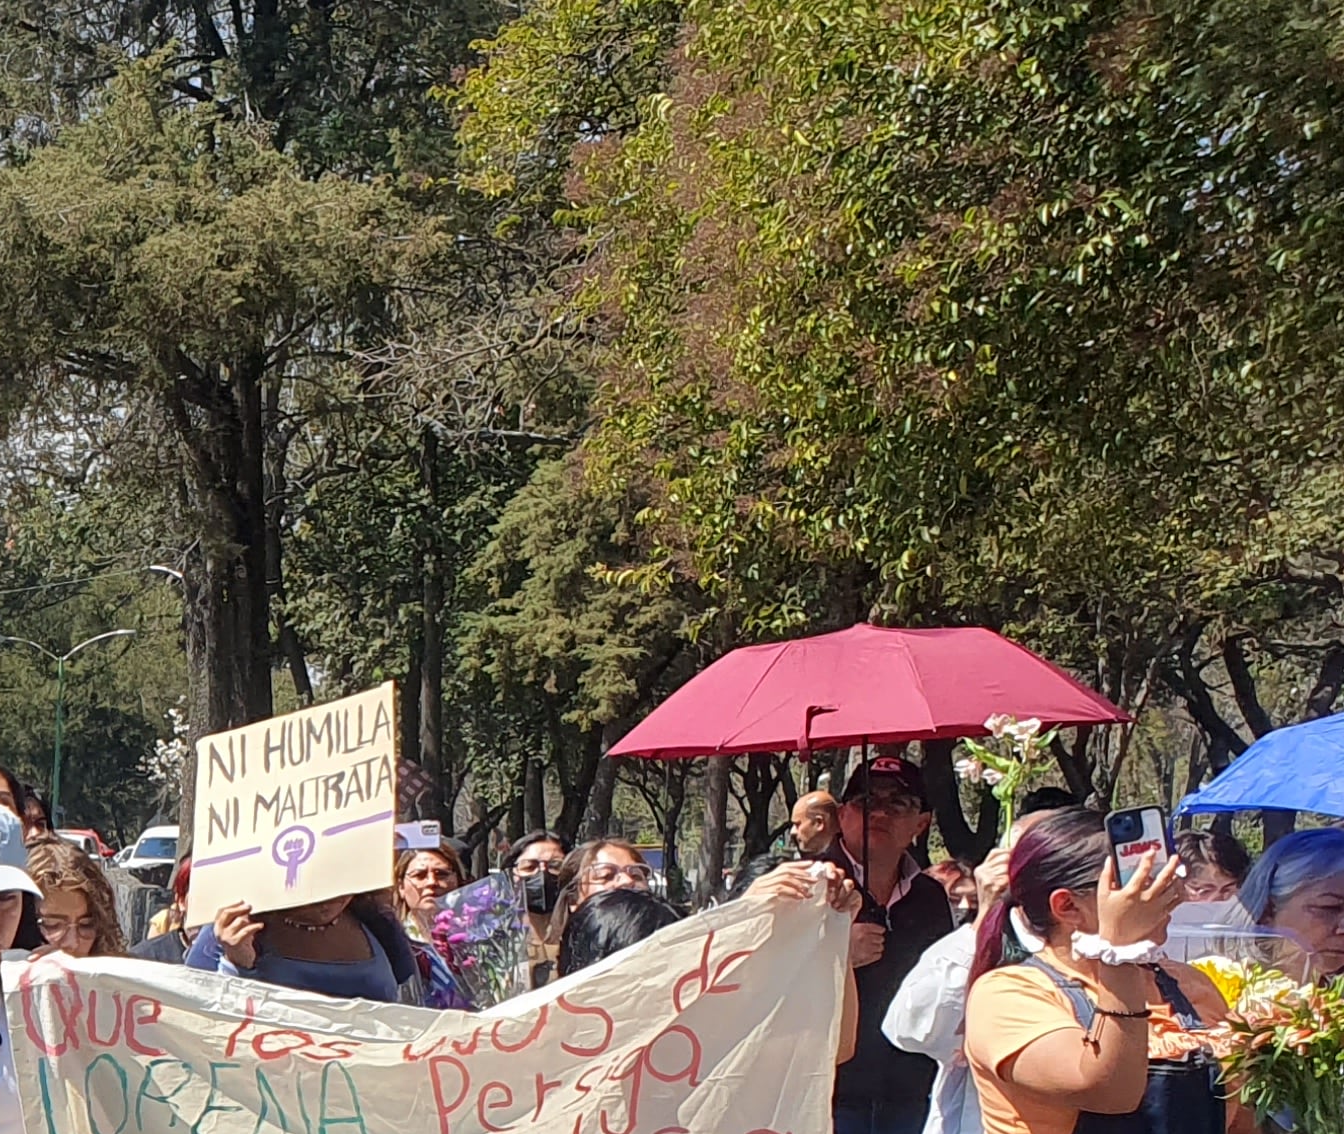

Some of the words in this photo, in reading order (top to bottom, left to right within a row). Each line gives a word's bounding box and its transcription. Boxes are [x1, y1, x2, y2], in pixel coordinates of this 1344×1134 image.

[208, 733, 246, 788] NI
[263, 700, 391, 773] HUMILLA
[208, 796, 239, 846] NI
[253, 753, 393, 833] MALTRATA
[19, 959, 169, 1056] Que
[225, 996, 362, 1061] los
